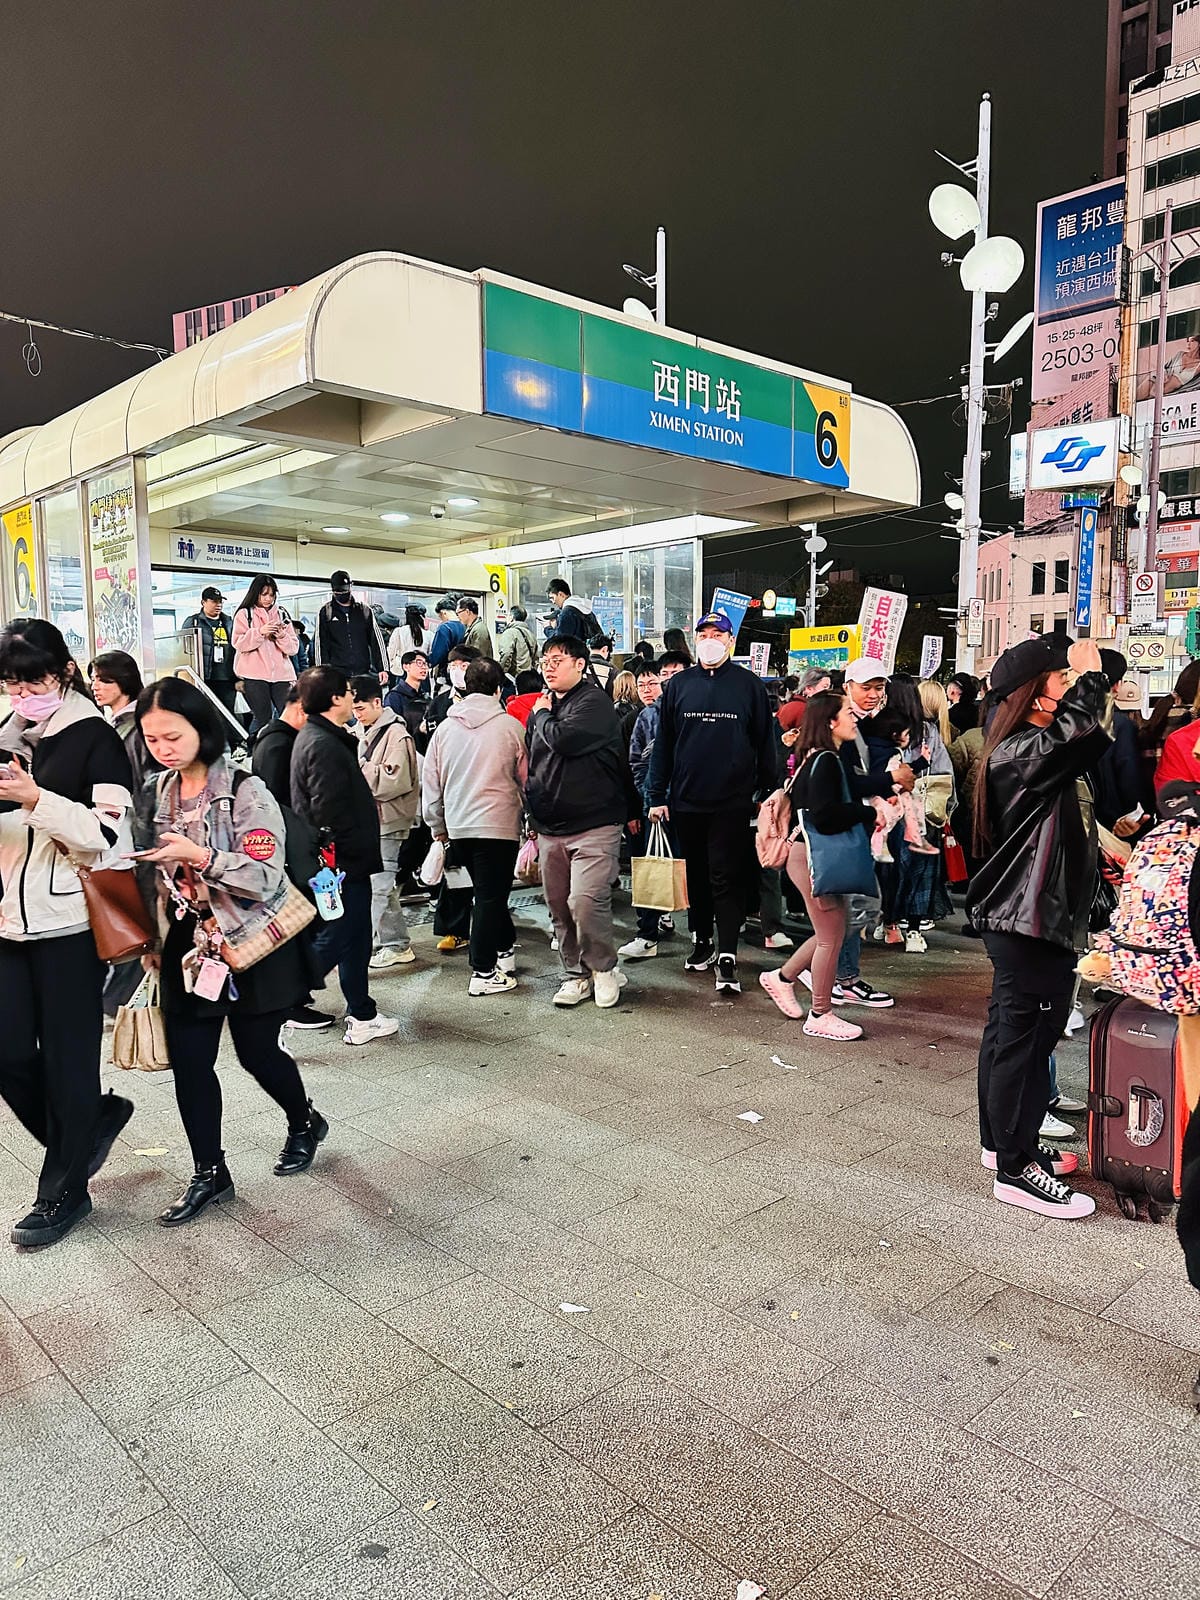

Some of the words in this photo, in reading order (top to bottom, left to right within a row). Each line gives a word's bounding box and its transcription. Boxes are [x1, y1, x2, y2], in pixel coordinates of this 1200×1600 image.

[1056, 199, 1125, 241] 龍邦豐
[1055, 245, 1118, 279] 近遇台北
[1054, 268, 1117, 300] 預演西城
[651, 360, 742, 423] 西門站
[649, 410, 690, 435] XIMEN
[693, 420, 744, 448] STATION
[814, 410, 840, 470] 6
[1160, 415, 1198, 434] GAME
[13, 536, 31, 610] 6
[489, 572, 501, 593] 6
